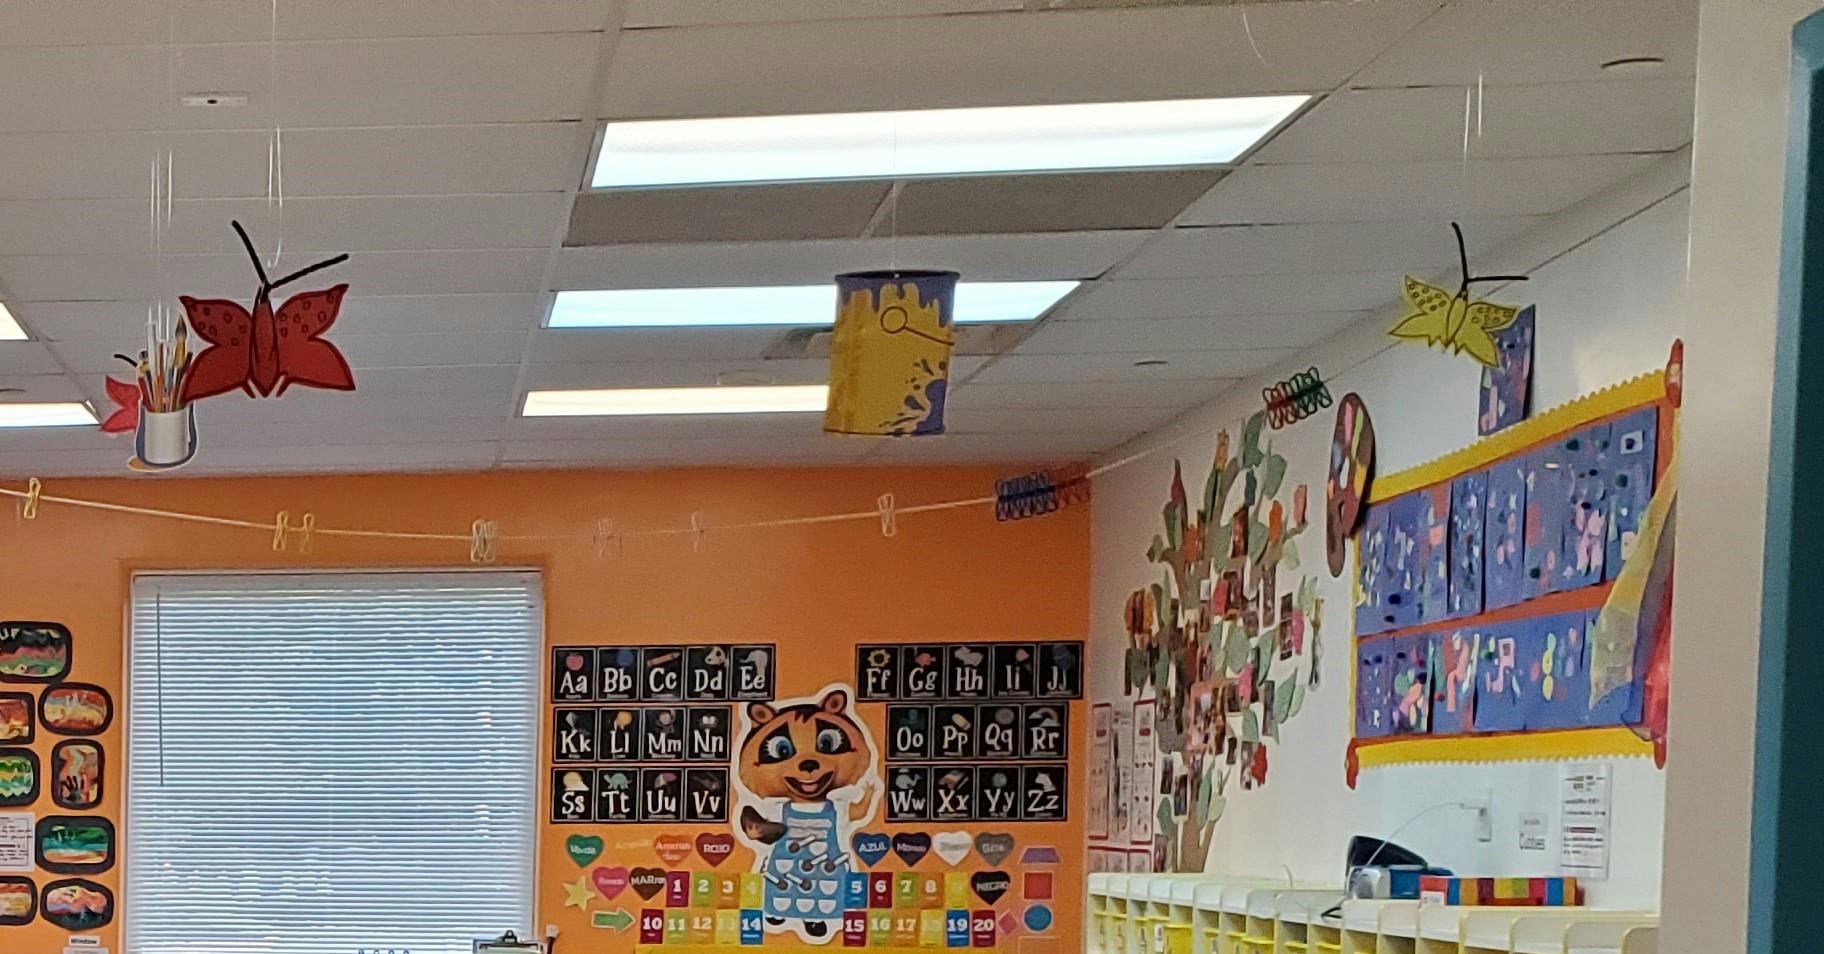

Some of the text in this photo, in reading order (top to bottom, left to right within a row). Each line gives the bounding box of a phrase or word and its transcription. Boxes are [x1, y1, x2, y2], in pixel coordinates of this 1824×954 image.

[560, 666, 766, 694] Aa Bb Cc Dd Ee
[866, 667, 891, 692] Ff
[908, 668, 938, 691] Gg
[955, 666, 983, 691] Hh
[560, 729, 592, 754] Kk
[648, 732, 682, 753] Mm
[693, 729, 724, 753] Nn
[896, 723, 1060, 754] Oo Pp Qq Rr
[562, 790, 721, 814] Ss Tt Uu Vv
[890, 788, 1059, 813] Ww Xx Yy Zz
[673, 879, 681, 892] 1
[698, 879, 709, 892] 2
[722, 881, 734, 893] 3
[851, 880, 863, 893] 5
[875, 880, 887, 893] 6
[900, 879, 912, 892] 7
[643, 917, 662, 930] 10
[667, 918, 686, 930] 11
[692, 916, 712, 930] 12
[742, 918, 762, 930] 14
[845, 919, 994, 932] 15 16 17 19 20
